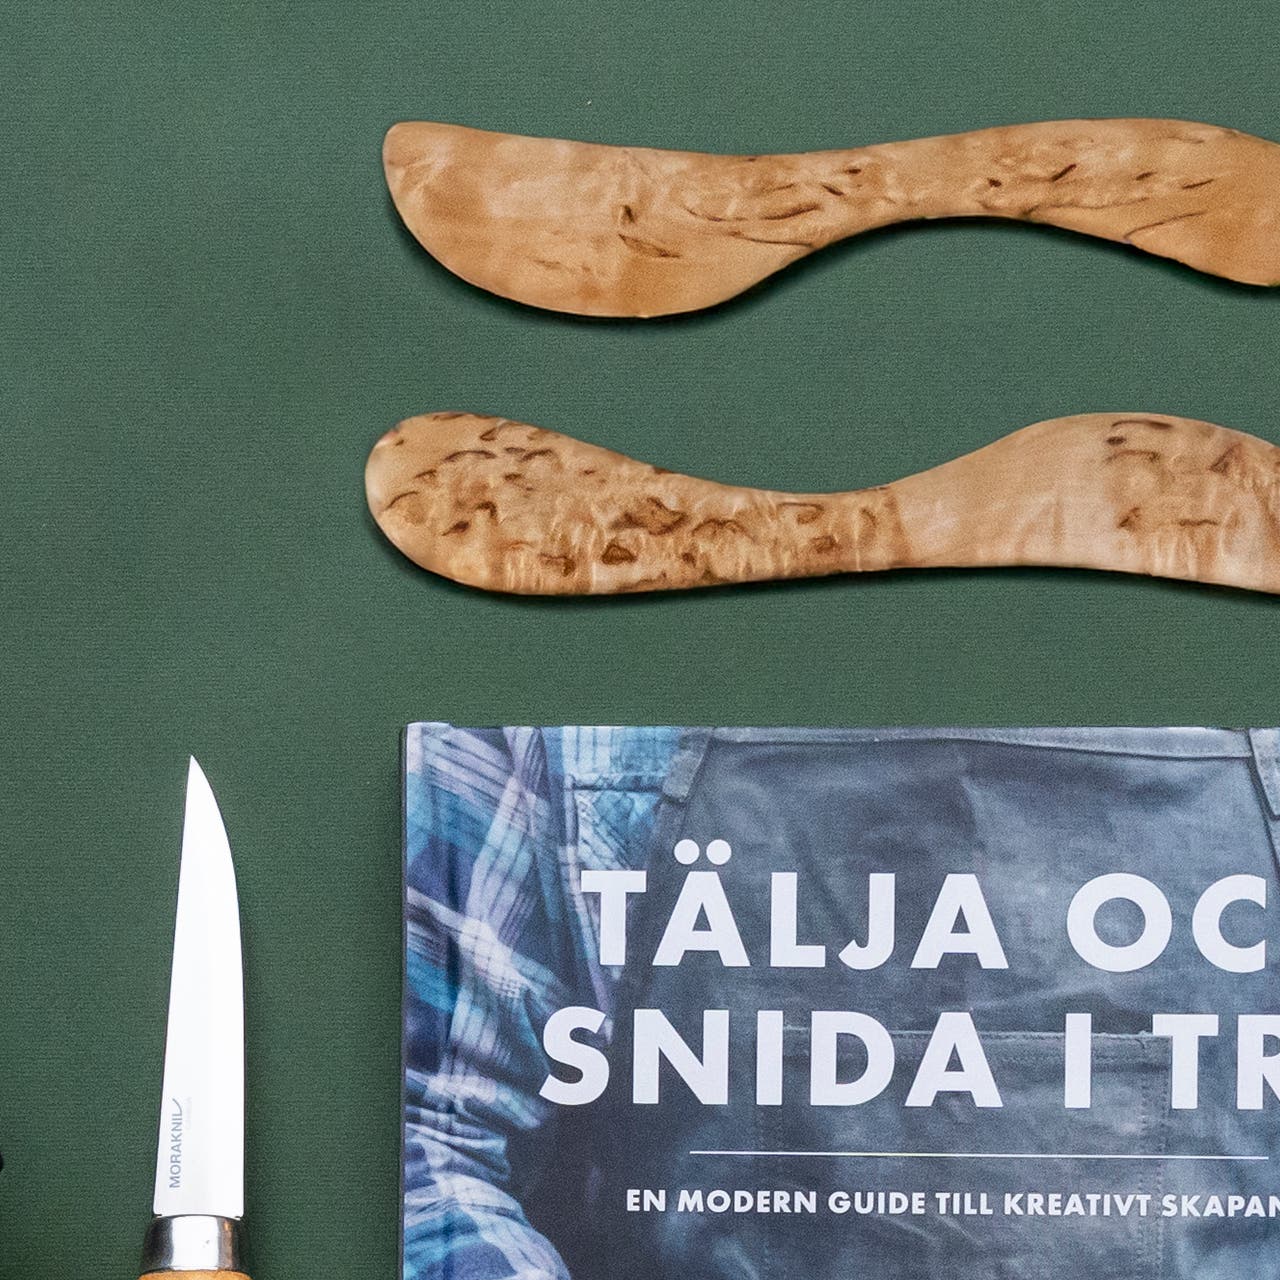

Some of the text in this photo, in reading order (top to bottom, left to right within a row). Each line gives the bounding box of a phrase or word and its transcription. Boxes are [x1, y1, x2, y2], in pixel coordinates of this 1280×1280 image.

[582, 839, 1008, 971] TÄLJA
[539, 1006, 1003, 1108] SNIDA
[1065, 1013, 1090, 1109] I
[626, 1188, 667, 1212] EN
[677, 1189, 819, 1215] MODERN
[827, 1191, 927, 1217] GUIDE
[935, 1192, 994, 1217] TILL
[1003, 1192, 1152, 1218] KREATIVT
